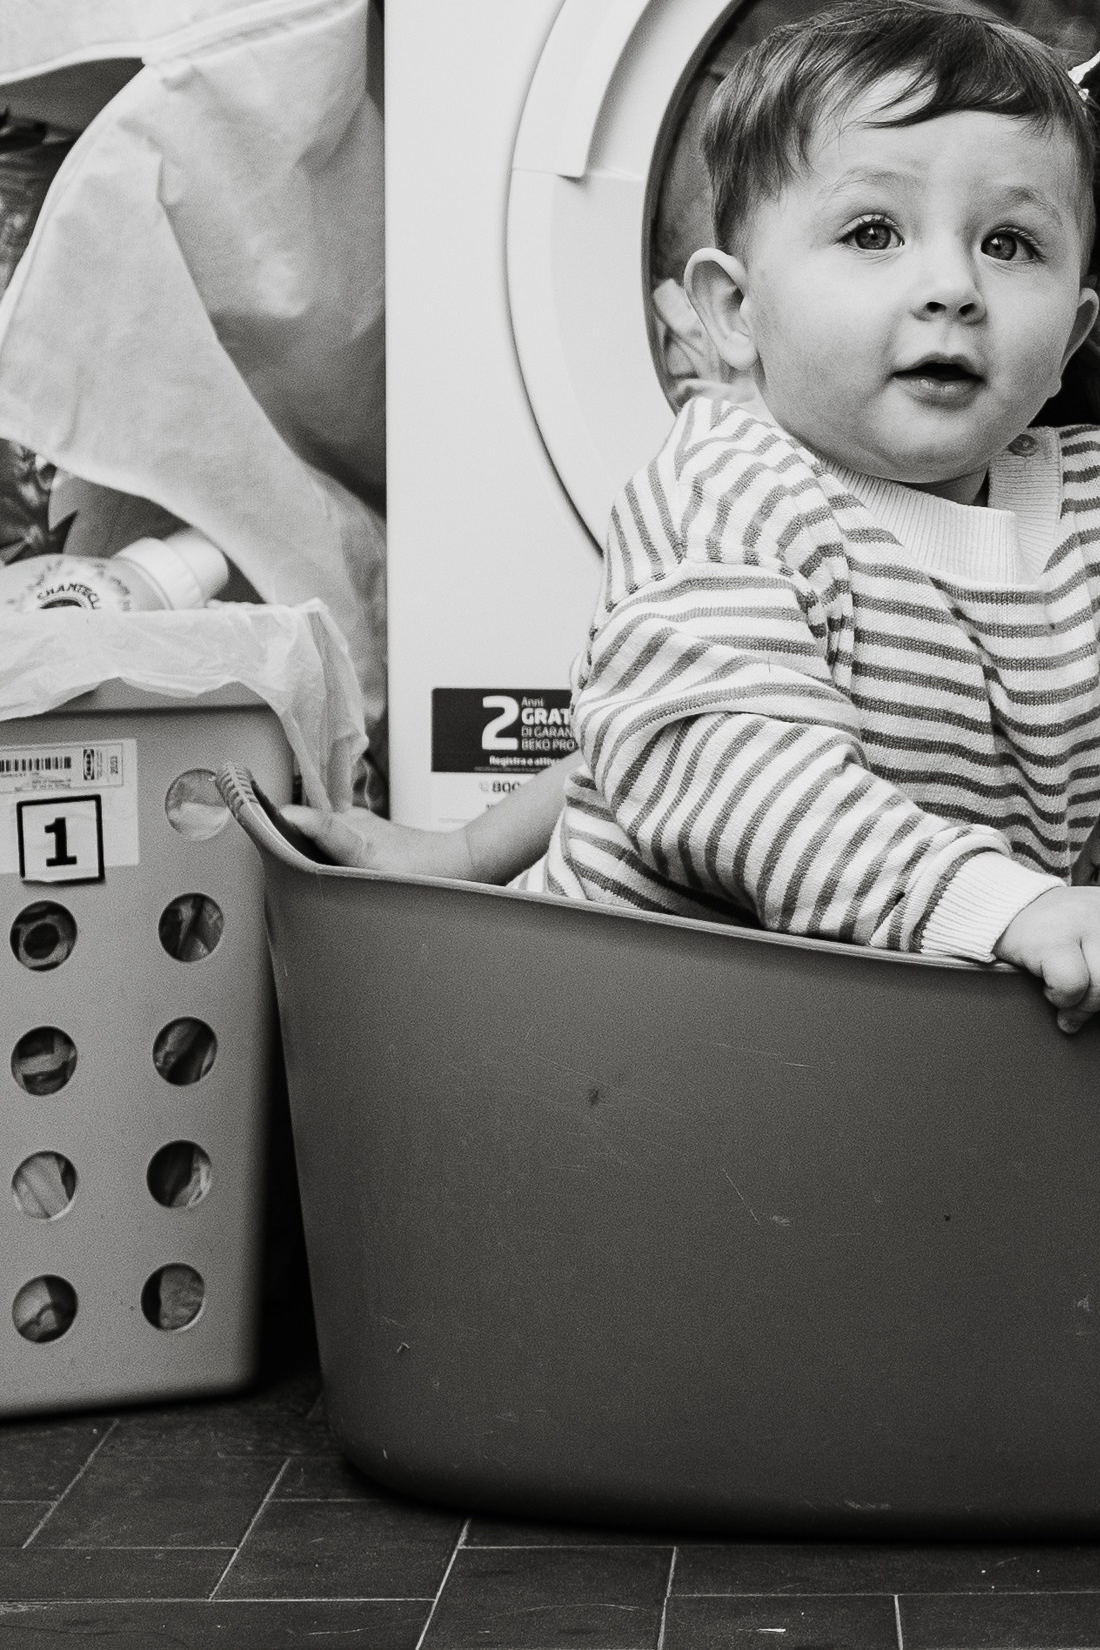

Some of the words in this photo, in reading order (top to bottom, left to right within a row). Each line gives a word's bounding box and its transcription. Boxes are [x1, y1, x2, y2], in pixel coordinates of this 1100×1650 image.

[521, 696, 544, 707] Anni
[481, 695, 520, 750] 2
[521, 707, 570, 725] GRAT
[521, 726, 532, 738] DI
[534, 726, 574, 738] GARAN
[521, 738, 551, 750] BEKO
[552, 738, 575, 751] PRO
[44, 817, 77, 867] 1
